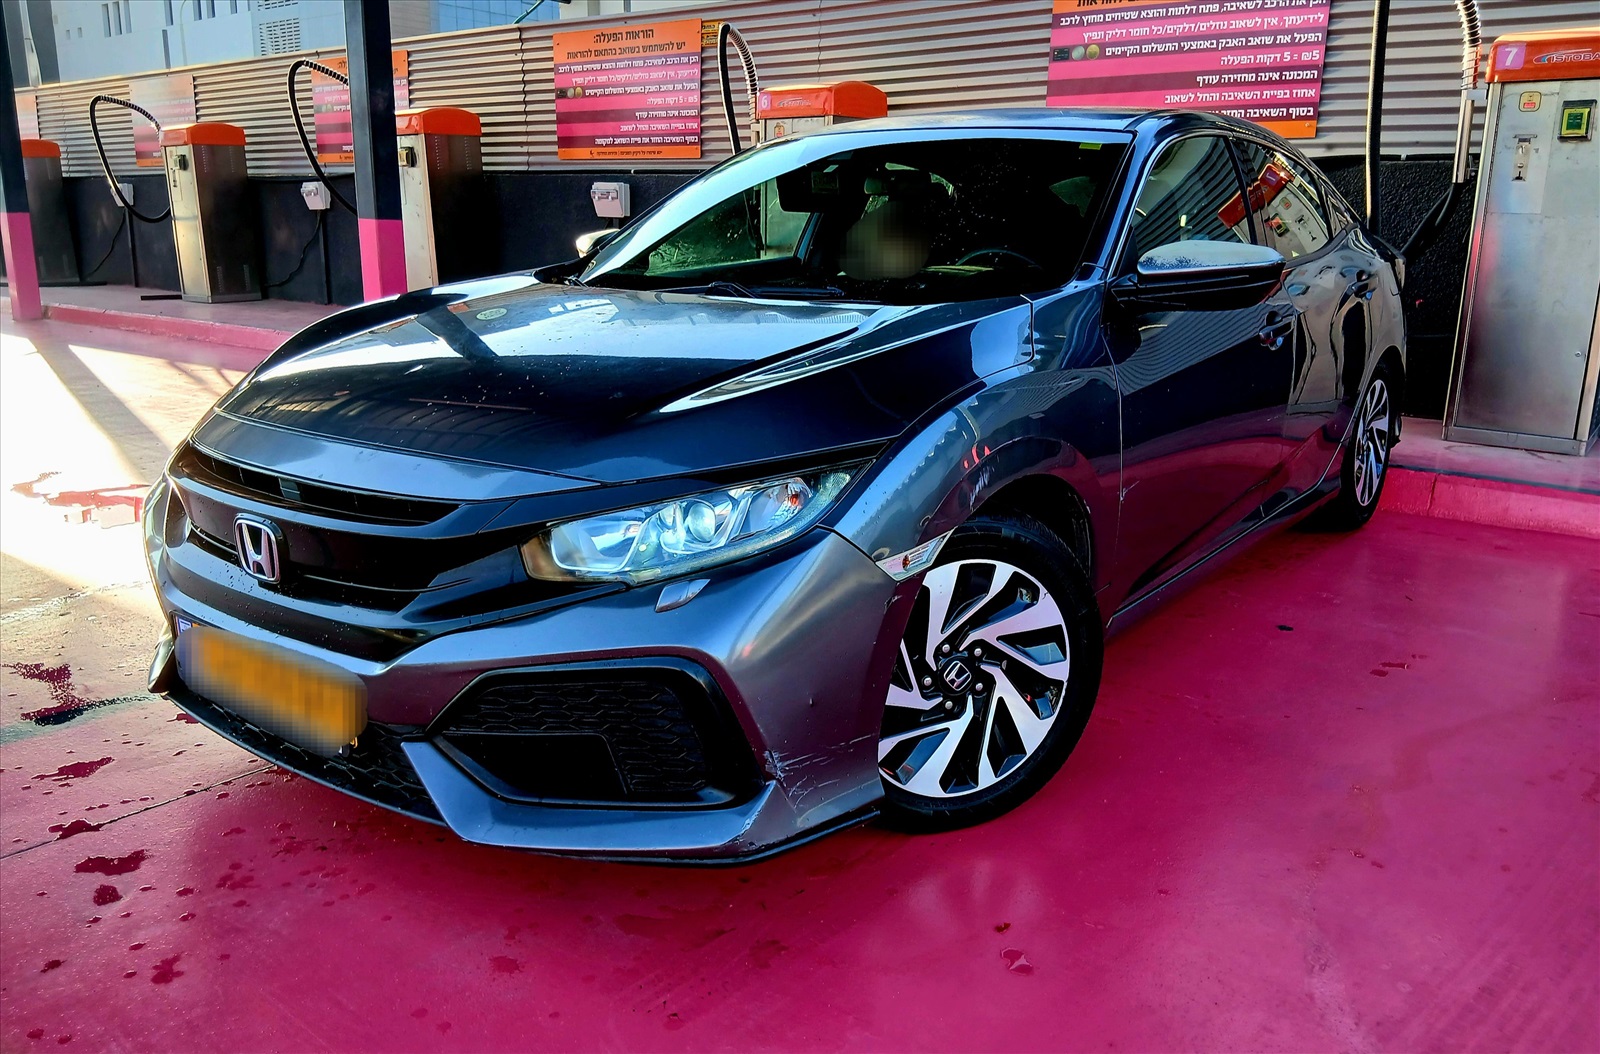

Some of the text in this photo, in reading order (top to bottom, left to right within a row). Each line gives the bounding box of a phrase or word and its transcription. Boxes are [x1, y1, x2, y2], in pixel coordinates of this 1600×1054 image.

[1168, 4, 1197, 16] דלתות
[1198, 4, 1219, 13] פתח
[1220, 0, 1262, 12] לשאיבה,
[1264, 0, 1289, 8] הרכב
[1106, 11, 1138, 22] שטיחים
[1141, 9, 1166, 18] והוצא
[1060, 16, 1080, 26] לרכב
[1082, 14, 1103, 26] מחוץ
[1230, 17, 1262, 28] לשאוב
[1264, 17, 1278, 29] אין
[594, 28, 654, 44] הוראות הפעלה:
[1106, 28, 1126, 41] דליק
[1128, 28, 1150, 36] חומר
[1106, 32, 1322, 56] הפעל את שואב האבק באמצעי התשלום הקיימים
[567, 41, 686, 60] יש להשתמש בשואב בהתאם להוראות
[1504, 47, 1518, 66] 7
[1220, 54, 1254, 66] הפעלה
[1256, 53, 1282, 66] דקות
[1283, 52, 1291, 62] 5
[1550, 52, 1600, 63] ISTOBA
[1196, 70, 1318, 88] המכונה אינה מחזירה עודף
[761, 95, 768, 109] 6
[1164, 88, 1316, 104] אחוז בפיית השאיבה והחל לשאוב
[1246, 107, 1286, 117] השאיבה
[1288, 106, 1314, 119] בסוף
